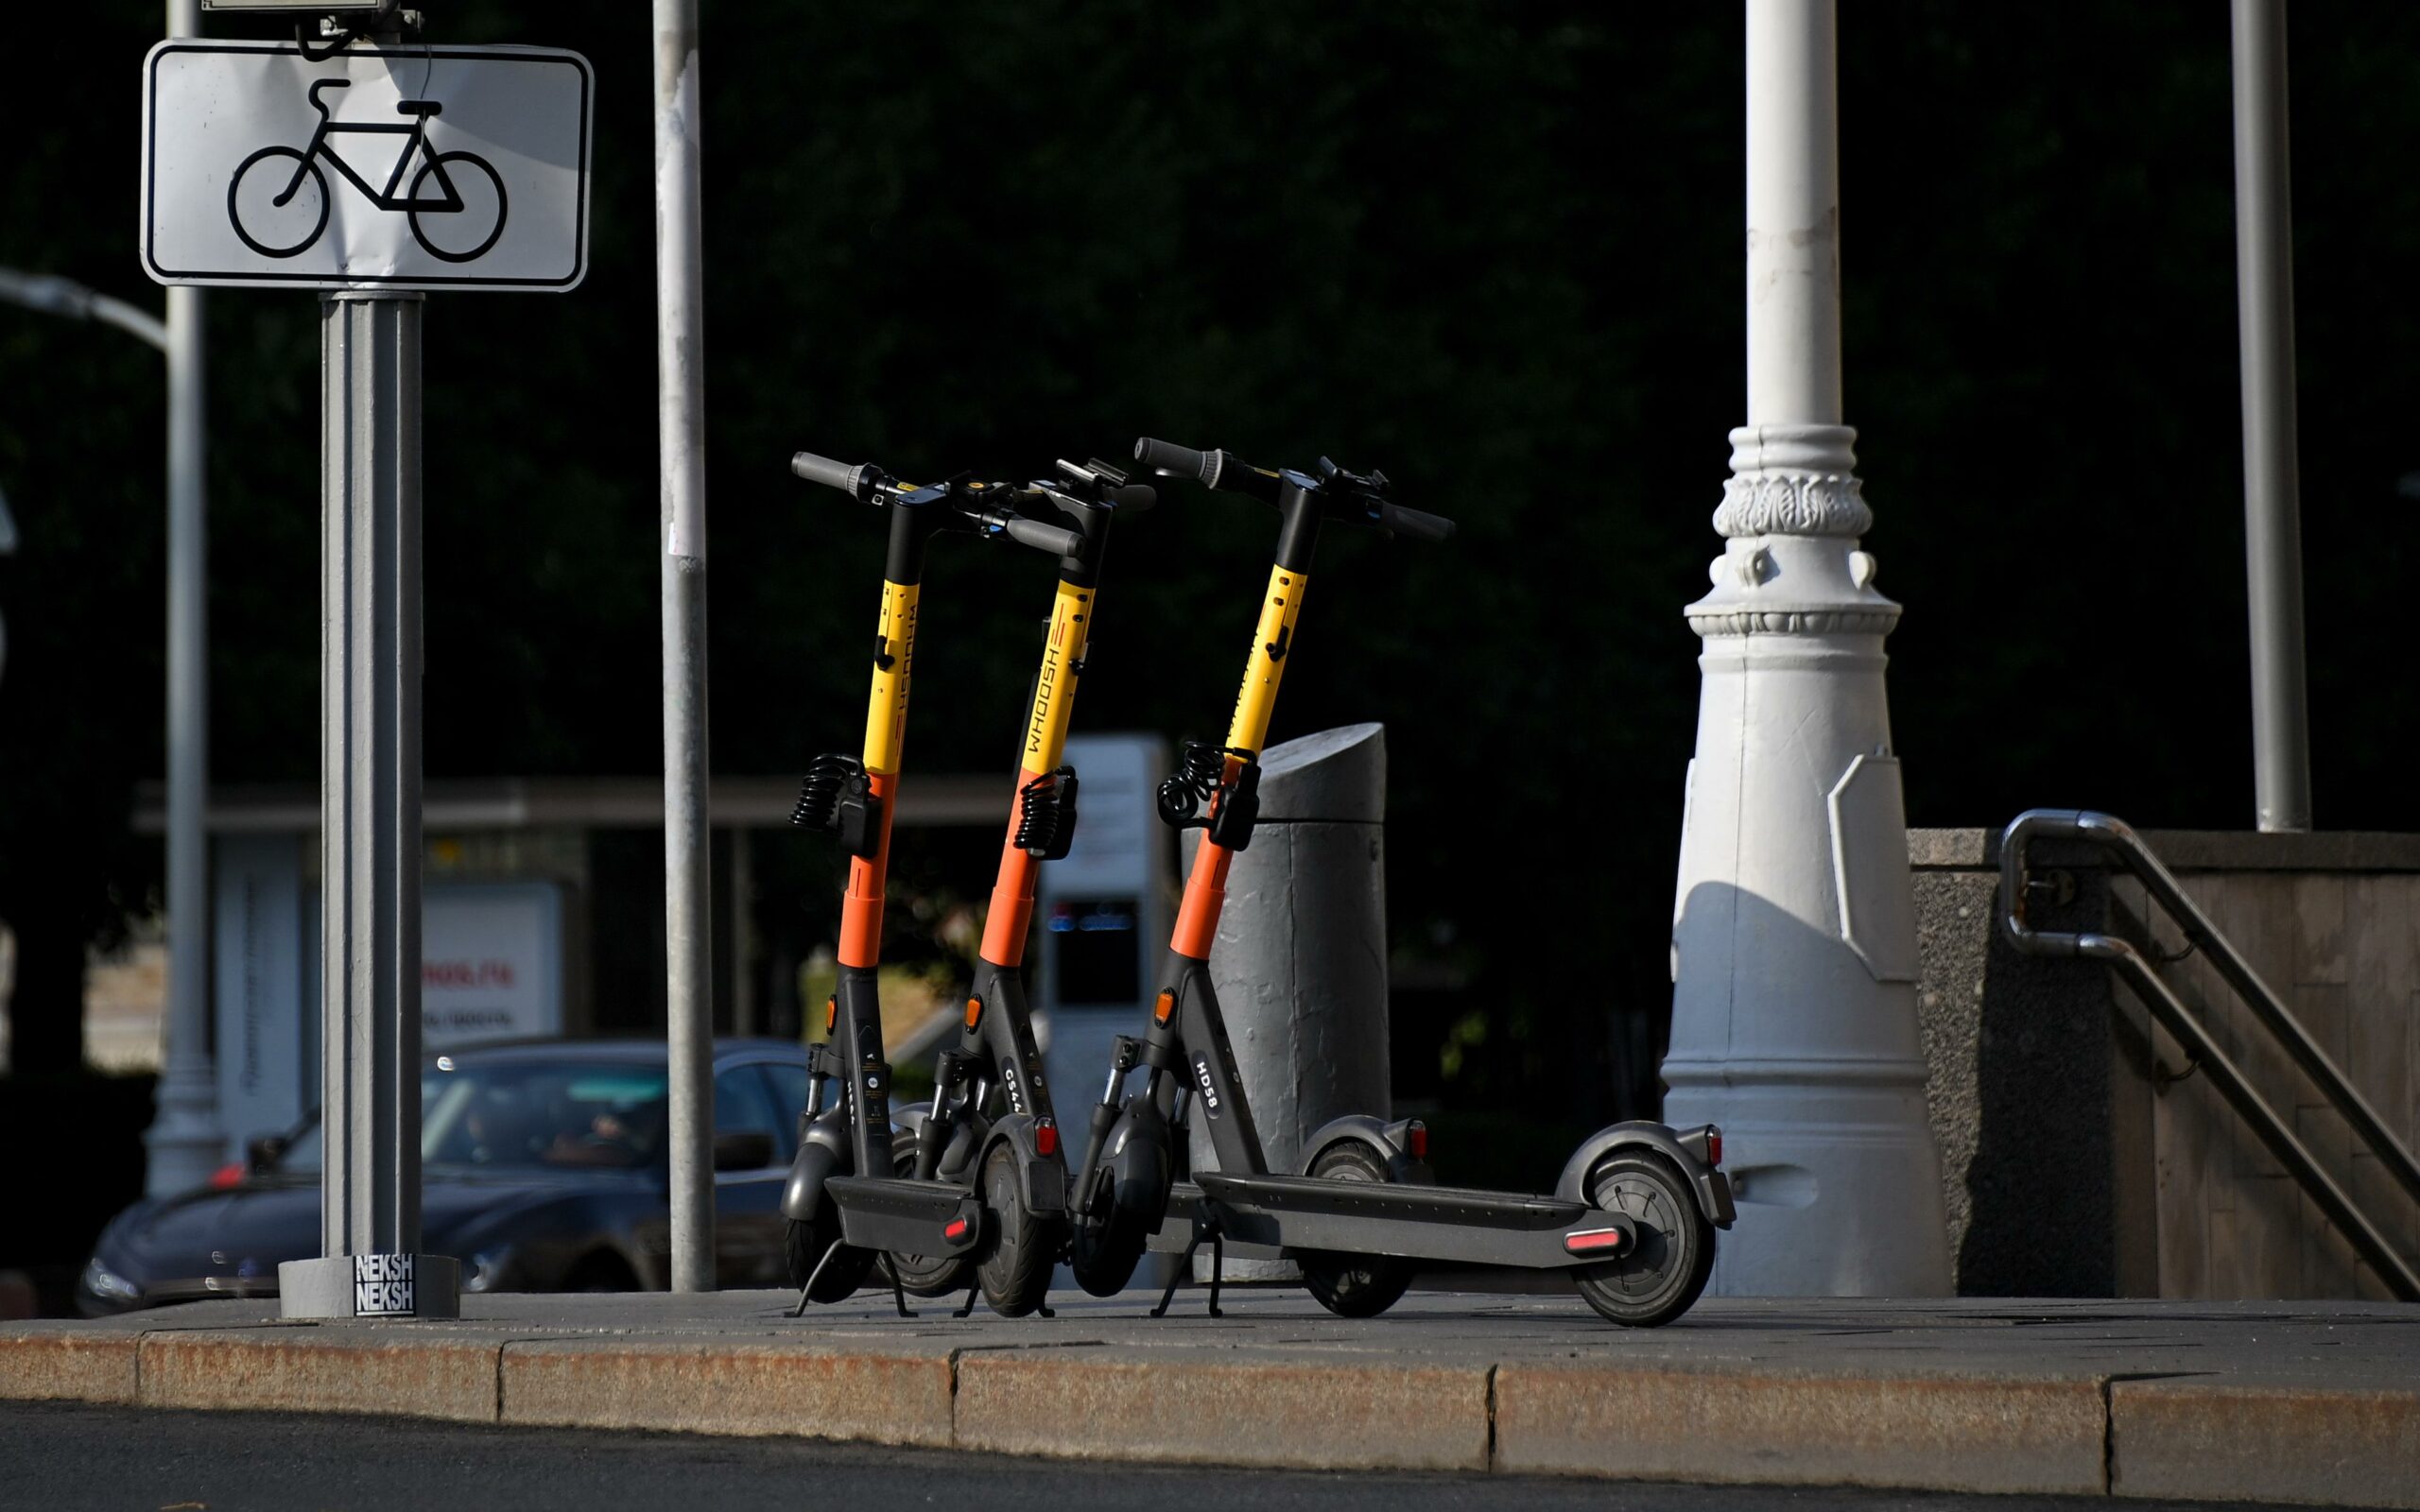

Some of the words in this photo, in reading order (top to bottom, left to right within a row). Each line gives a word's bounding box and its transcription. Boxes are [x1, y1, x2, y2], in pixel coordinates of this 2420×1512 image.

[1028, 648, 1060, 753] WHOOSH
[1005, 1069, 1022, 1113] GS44
[1196, 1061, 1218, 1108] HD58
[355, 1254, 413, 1281] NEKSH
[355, 1281, 413, 1312] NEKSH
